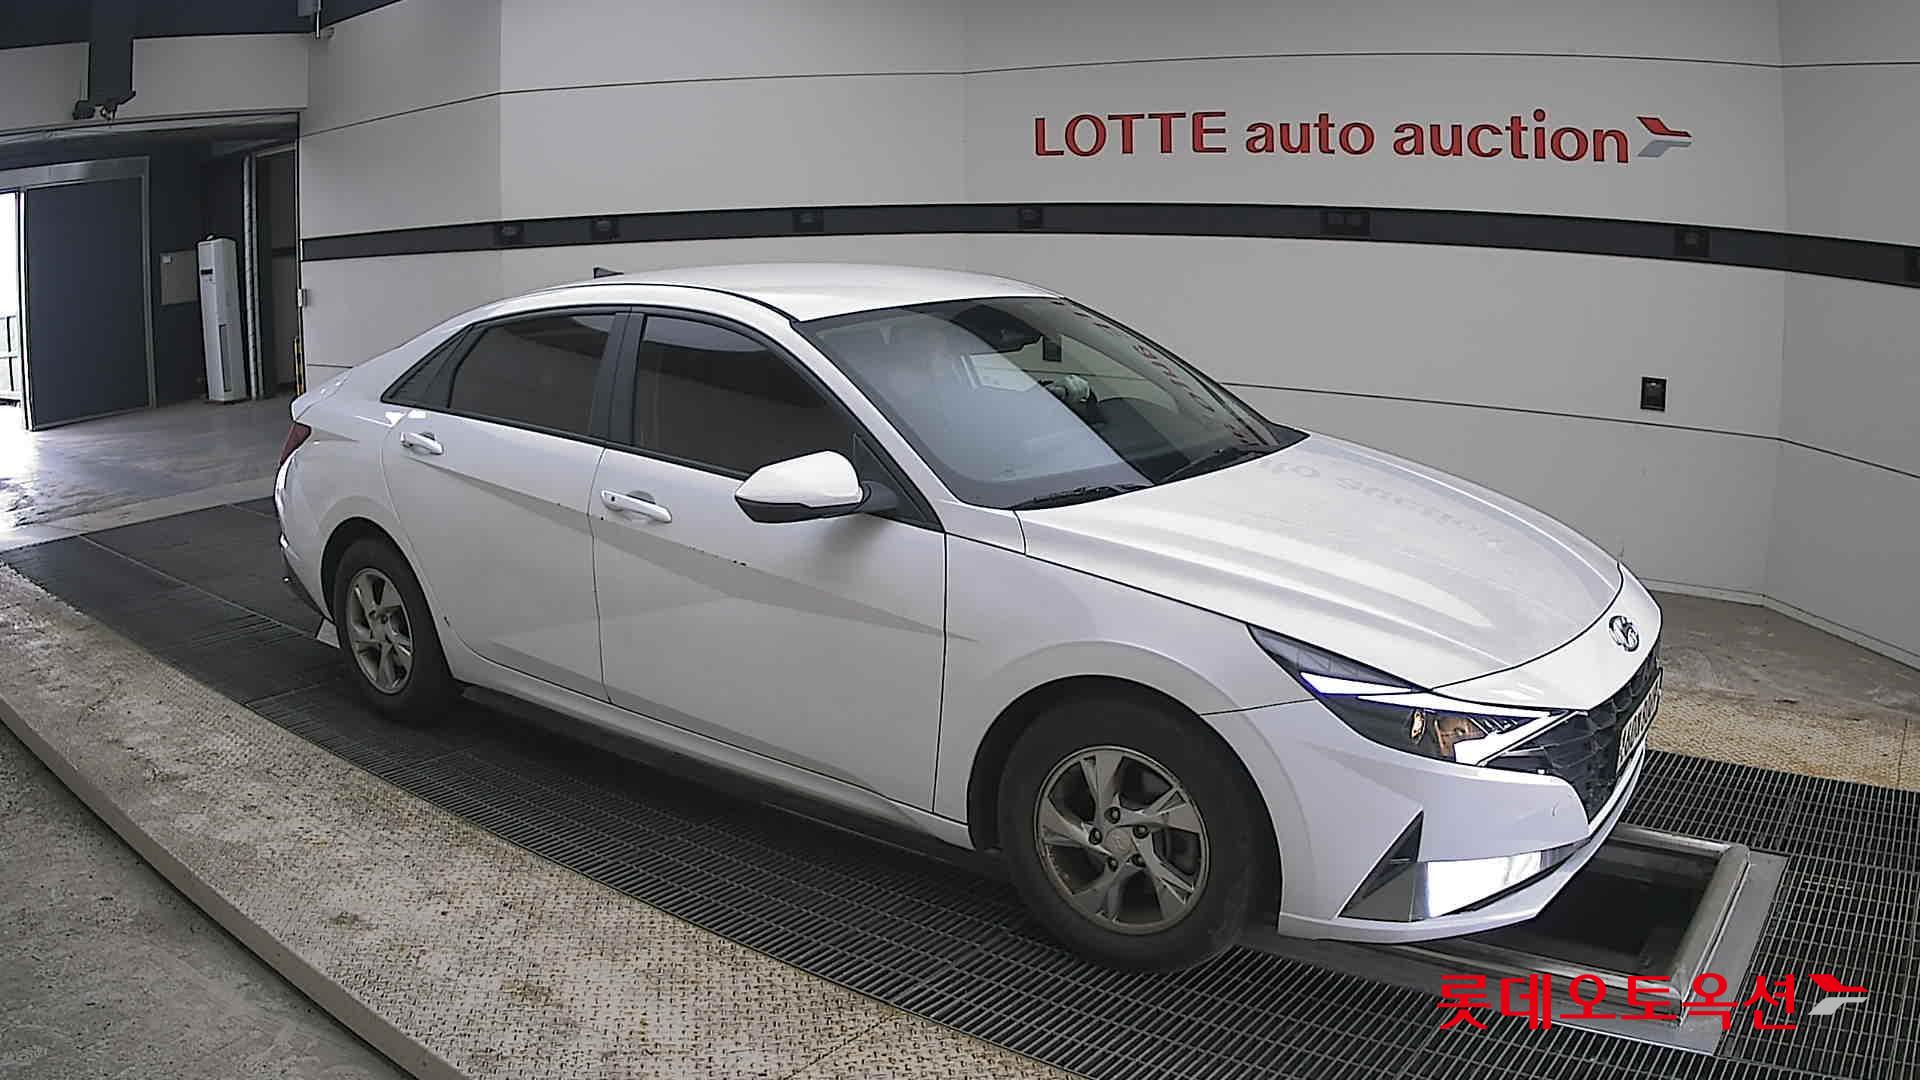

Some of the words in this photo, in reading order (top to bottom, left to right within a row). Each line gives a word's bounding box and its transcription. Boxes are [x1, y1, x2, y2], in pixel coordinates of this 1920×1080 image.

[1035, 111, 1227, 157] LOTTE
[1245, 113, 1375, 155] auto
[1392, 109, 1629, 163] auction
